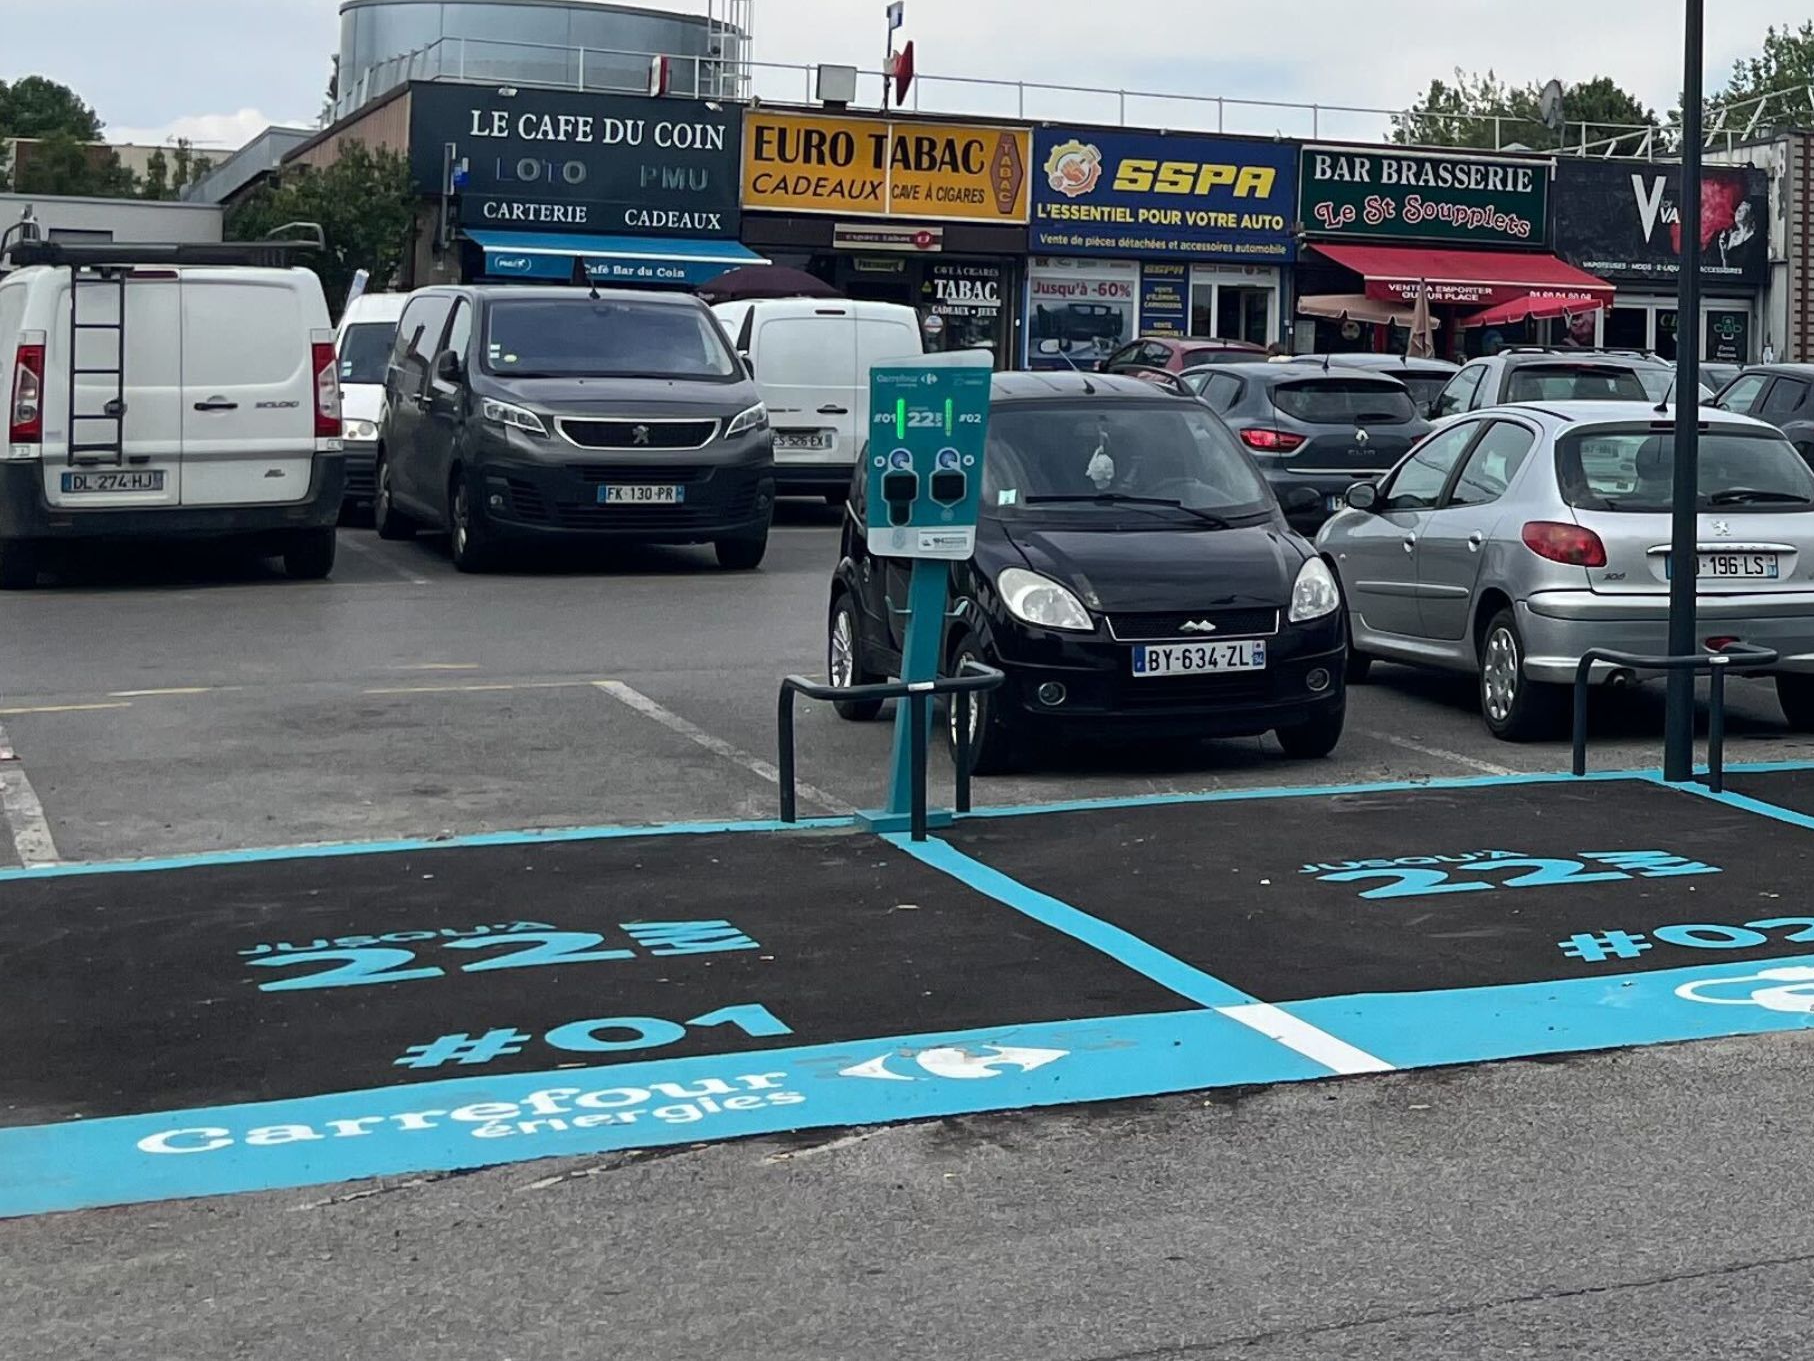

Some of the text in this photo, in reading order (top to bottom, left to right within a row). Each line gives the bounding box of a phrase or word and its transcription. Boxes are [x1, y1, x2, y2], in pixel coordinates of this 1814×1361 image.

[470, 110, 726, 150] LE CAFE DU COIN
[754, 125, 984, 175] EURO TABAC
[496, 157, 587, 184] LOTO
[640, 164, 709, 190] PMU
[1000, 143, 1013, 203] TABAC
[1112, 159, 1277, 199] SSPA
[1314, 155, 1533, 193] BAR BRASSERIE
[752, 172, 883, 201] CADEAUX
[892, 185, 920, 201] CAVE
[936, 187, 985, 204] CIGARES
[483, 201, 722, 230] CARTERIE CADEAUX
[1037, 203, 1284, 231] L'ESSENTIEL POUR VOTRE AUTO
[1314, 194, 1530, 238] Le St Soupplets
[1631, 174, 1667, 244] V
[1040, 233, 1287, 255] Vente de pièces détachées et accessoires automobile
[613, 265, 634, 276] Bar
[638, 265, 653, 277] du
[657, 267, 685, 278] Coin
[934, 279, 998, 301] TABAC
[1033, 281, 1131, 298] Jusqu'à -60%
[1435, 285, 1493, 296] EMPORTER
[1444, 293, 1478, 302] PLACE
[932, 305, 998, 318] CADEAUX JEUX
[907, 412, 935, 427] 22
[1316, 858, 1633, 899] 22
[245, 931, 637, 992] 22
[393, 1003, 795, 1069] #01
[137, 1070, 789, 1155] Carrefour
[471, 1089, 807, 1139] énergies
